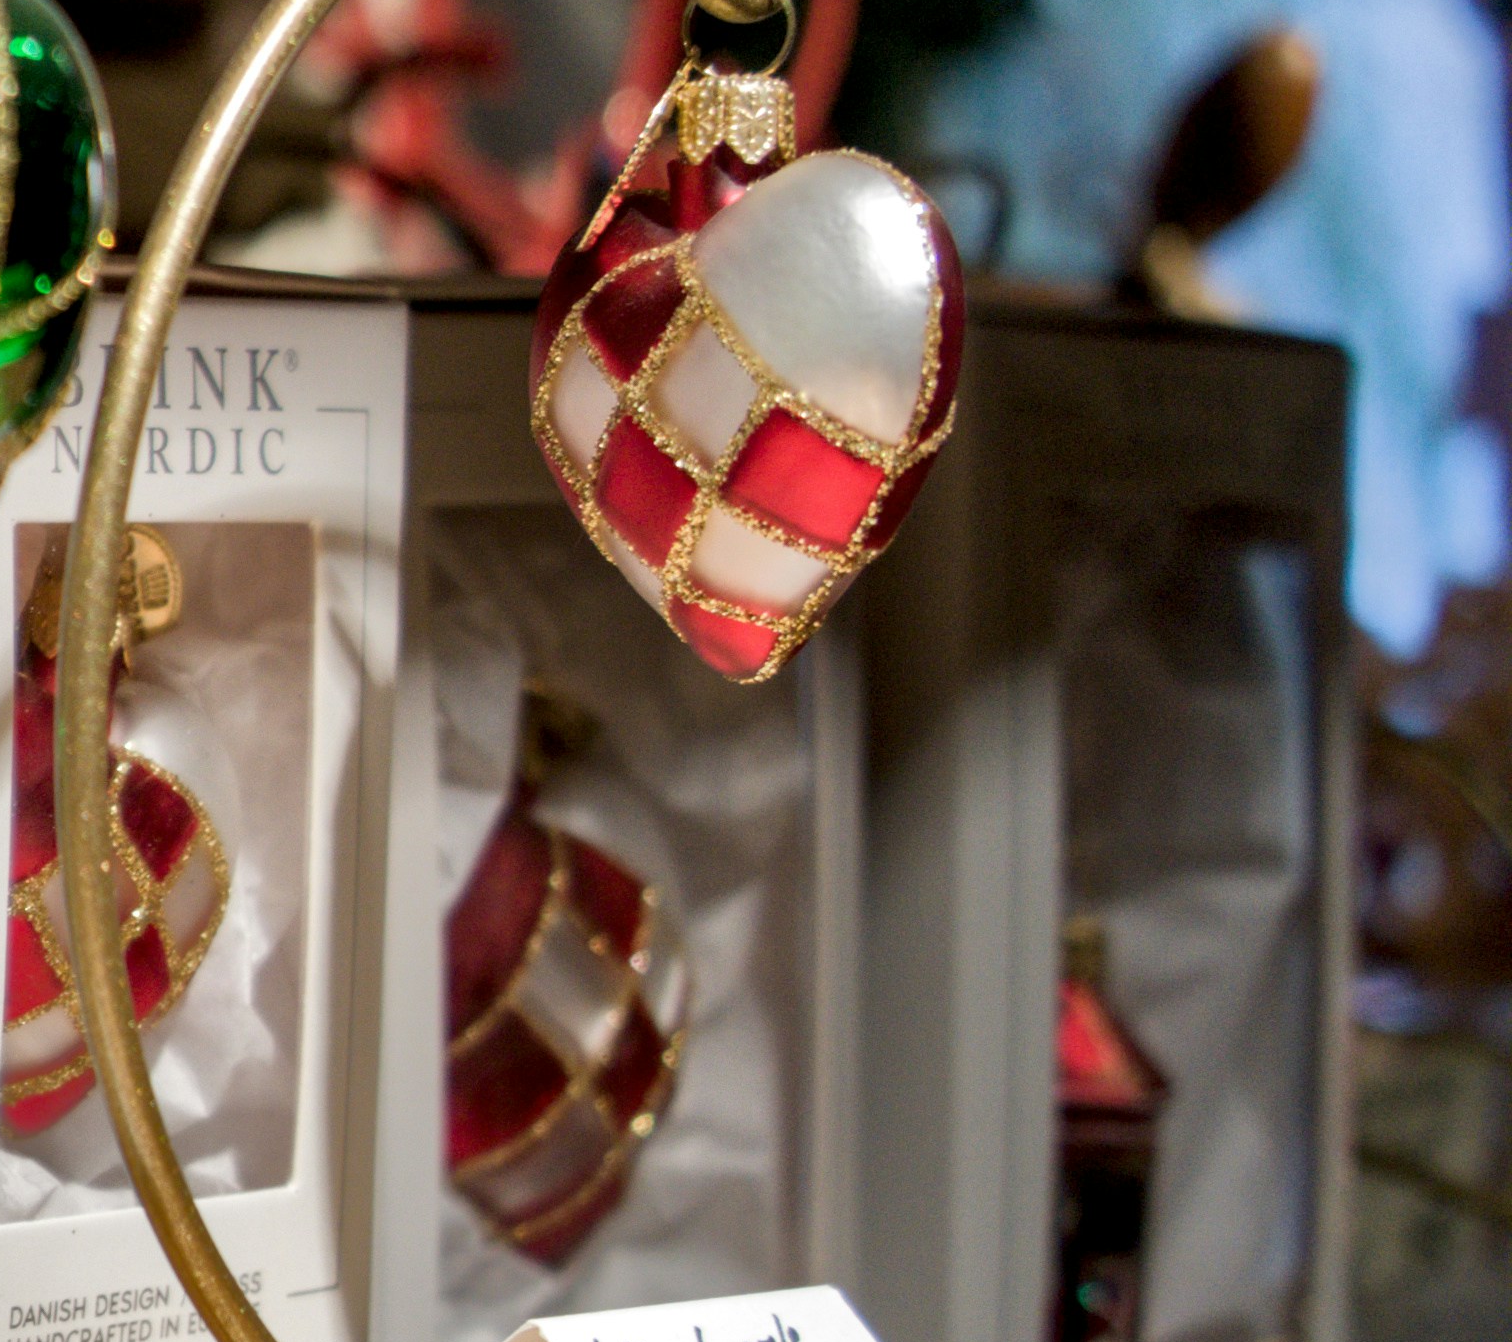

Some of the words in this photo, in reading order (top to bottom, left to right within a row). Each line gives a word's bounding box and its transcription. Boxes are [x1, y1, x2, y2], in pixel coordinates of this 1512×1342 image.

[51, 424, 286, 475] NRDIC
[9, 1291, 86, 1330] DANISH
[95, 1284, 170, 1318] DESIGN
[160, 1315, 180, 1340] IN
